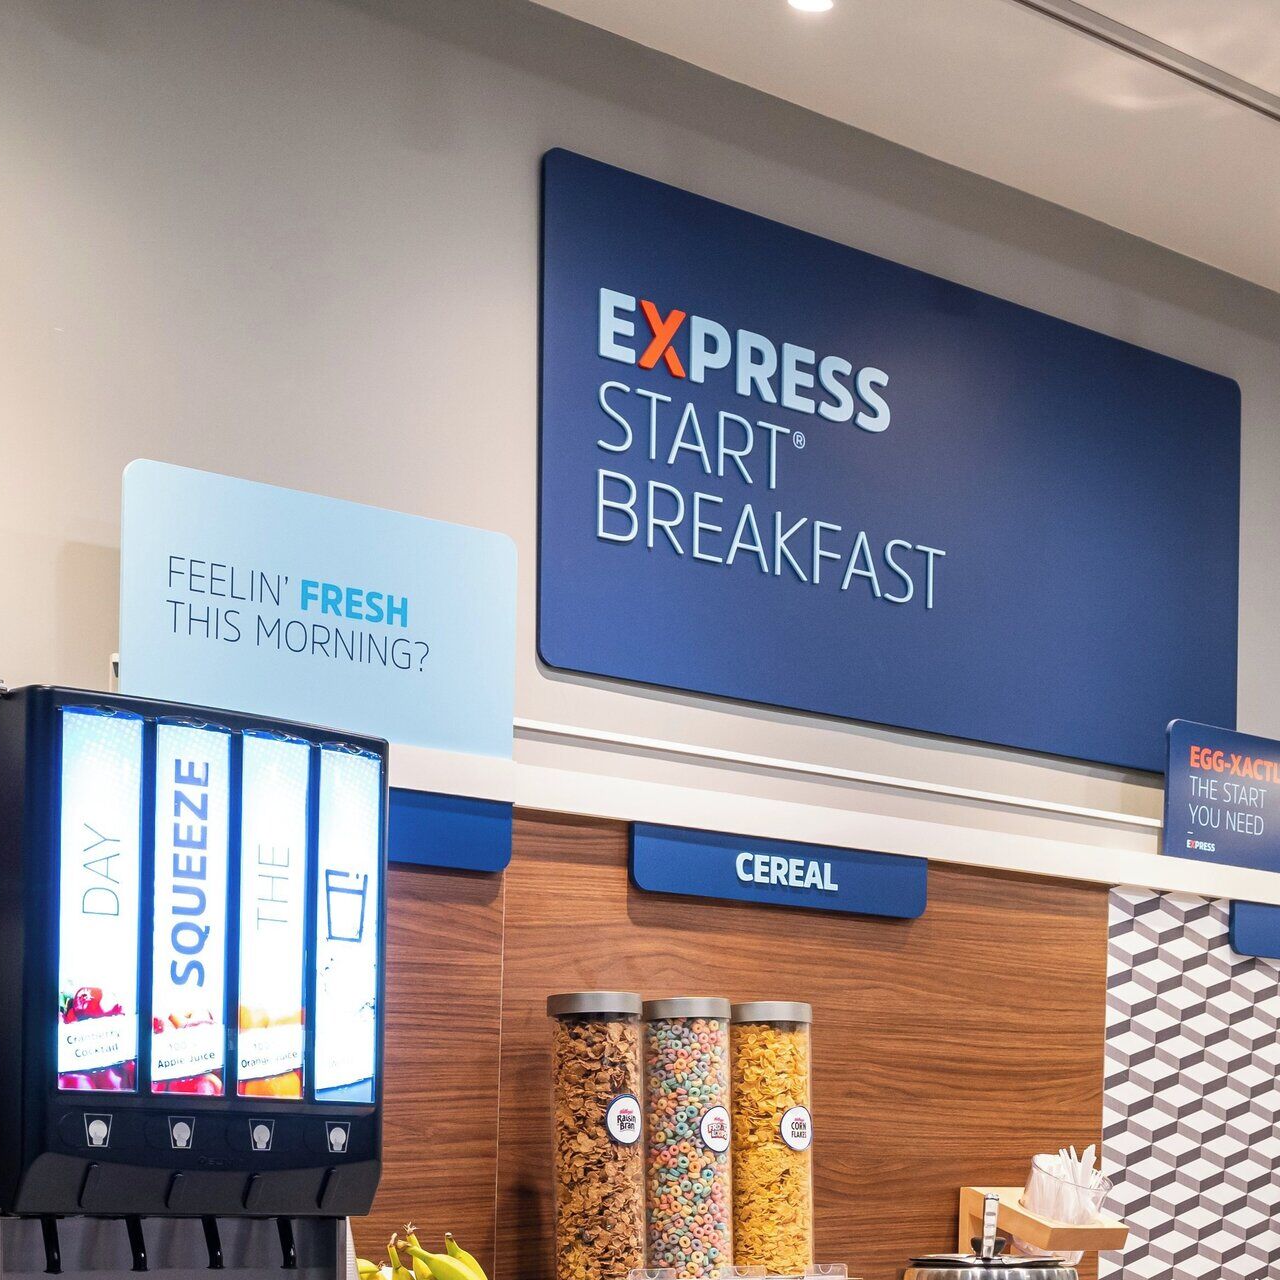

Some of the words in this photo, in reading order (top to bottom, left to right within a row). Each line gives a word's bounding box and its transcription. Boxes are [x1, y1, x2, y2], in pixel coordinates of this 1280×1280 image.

[598, 287, 891, 433] EXPRESS
[596, 467, 946, 610] BREAKFAST
[300, 578, 408, 628] FRESH
[166, 599, 241, 643] THIS
[256, 614, 430, 672] MORNING?
[1189, 775, 1218, 801] THE
[1223, 782, 1267, 809] START
[1188, 803, 1221, 829] YOU
[1225, 810, 1264, 836] NEED
[1186, 839, 1216, 852] EXPRESS
[82, 823, 121, 916] DAY
[170, 758, 210, 988] SQUEEZE
[257, 843, 290, 931] THE
[734, 851, 839, 892] CEREAL
[616, 1114, 637, 1123] Raisin
[619, 1121, 636, 1131] Bran
[790, 1121, 807, 1131] CORN
